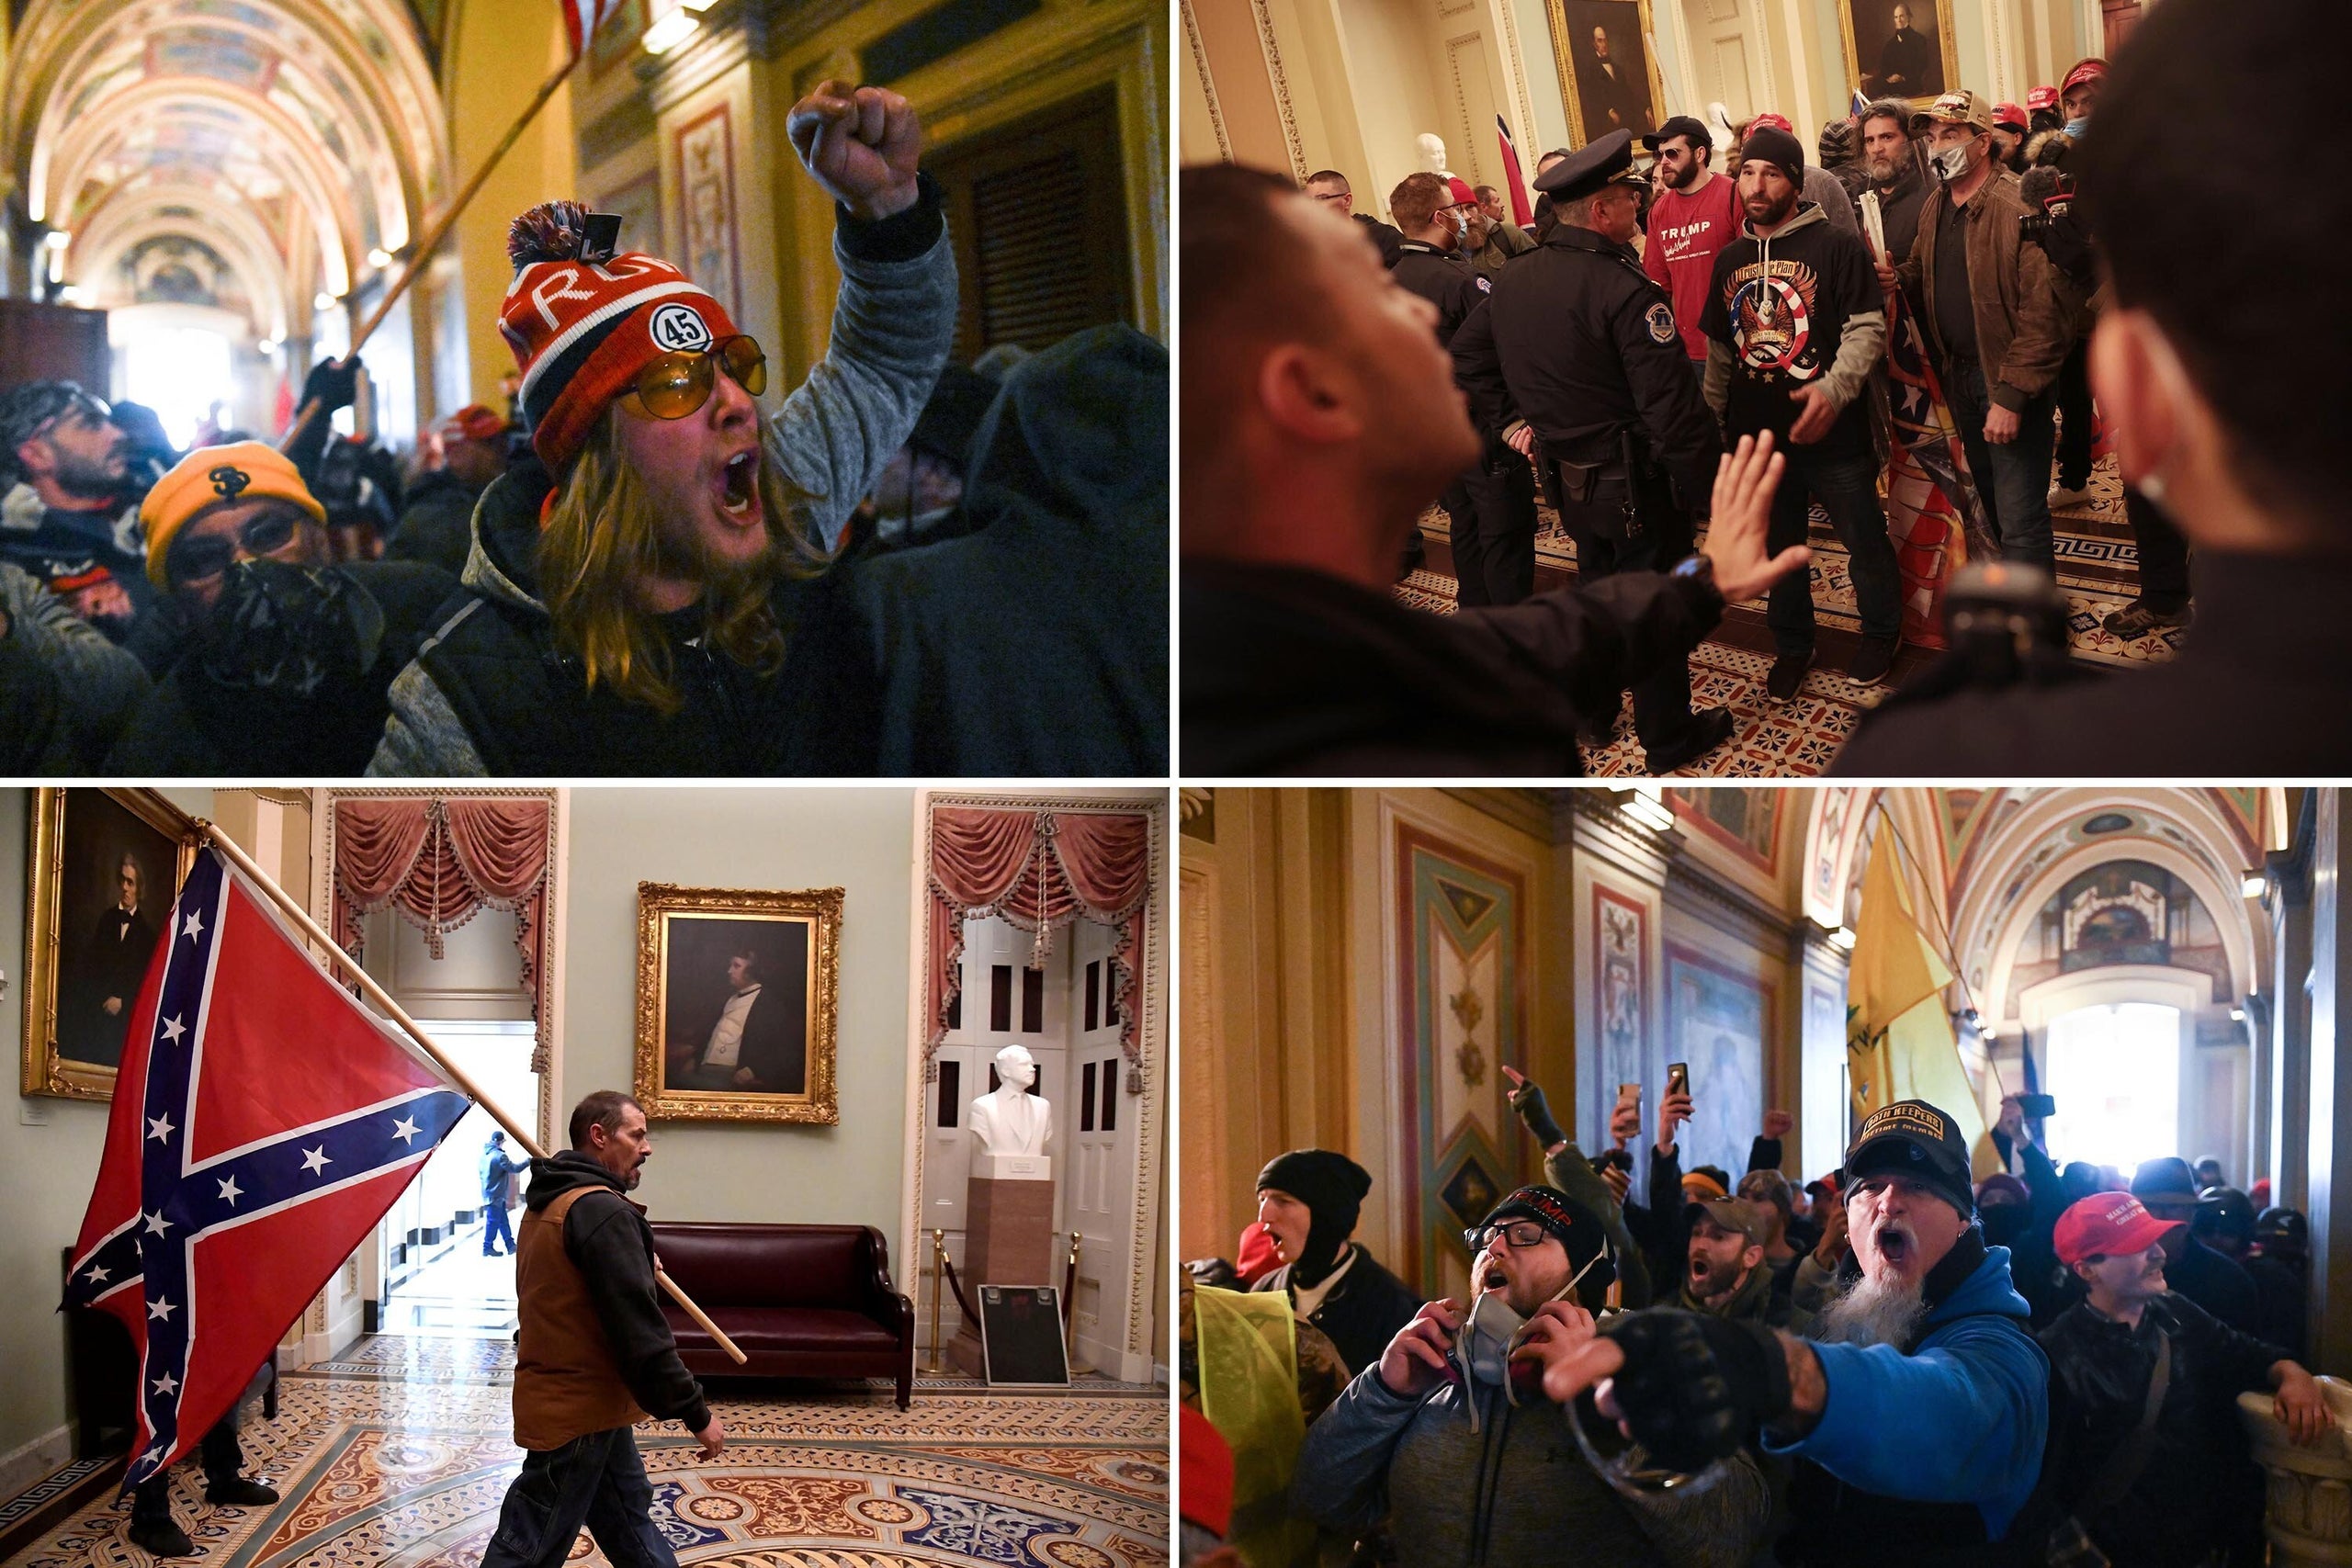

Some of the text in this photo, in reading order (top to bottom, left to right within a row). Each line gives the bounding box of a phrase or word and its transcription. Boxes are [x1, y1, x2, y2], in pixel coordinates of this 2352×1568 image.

[1661, 220, 1711, 241] TRUMP
[1761, 263, 1774, 276] Te
[1776, 261, 1793, 276] Plan
[664, 312, 700, 345] 45
[1867, 1106, 1939, 1128] OATH KEEPERS
